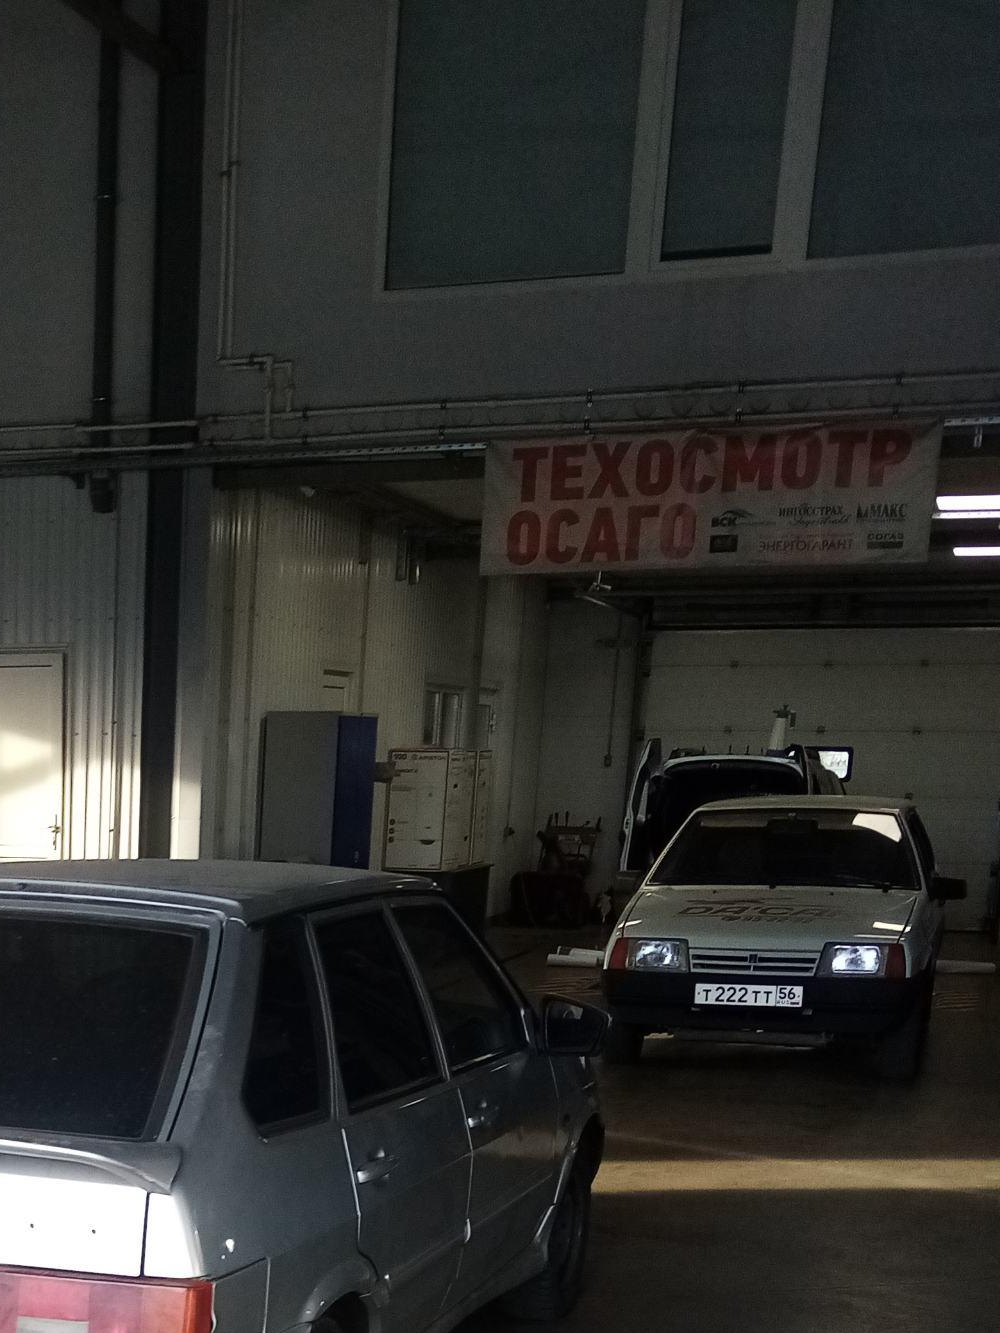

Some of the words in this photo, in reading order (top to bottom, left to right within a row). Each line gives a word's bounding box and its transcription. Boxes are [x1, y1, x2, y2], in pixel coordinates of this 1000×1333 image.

[512, 427, 914, 503] ТЕХОСМОТР
[870, 503, 908, 518] МАКС
[711, 516, 738, 528] ВСК
[505, 502, 697, 567] ОСАГО
[778, 987, 796, 1000] 56
